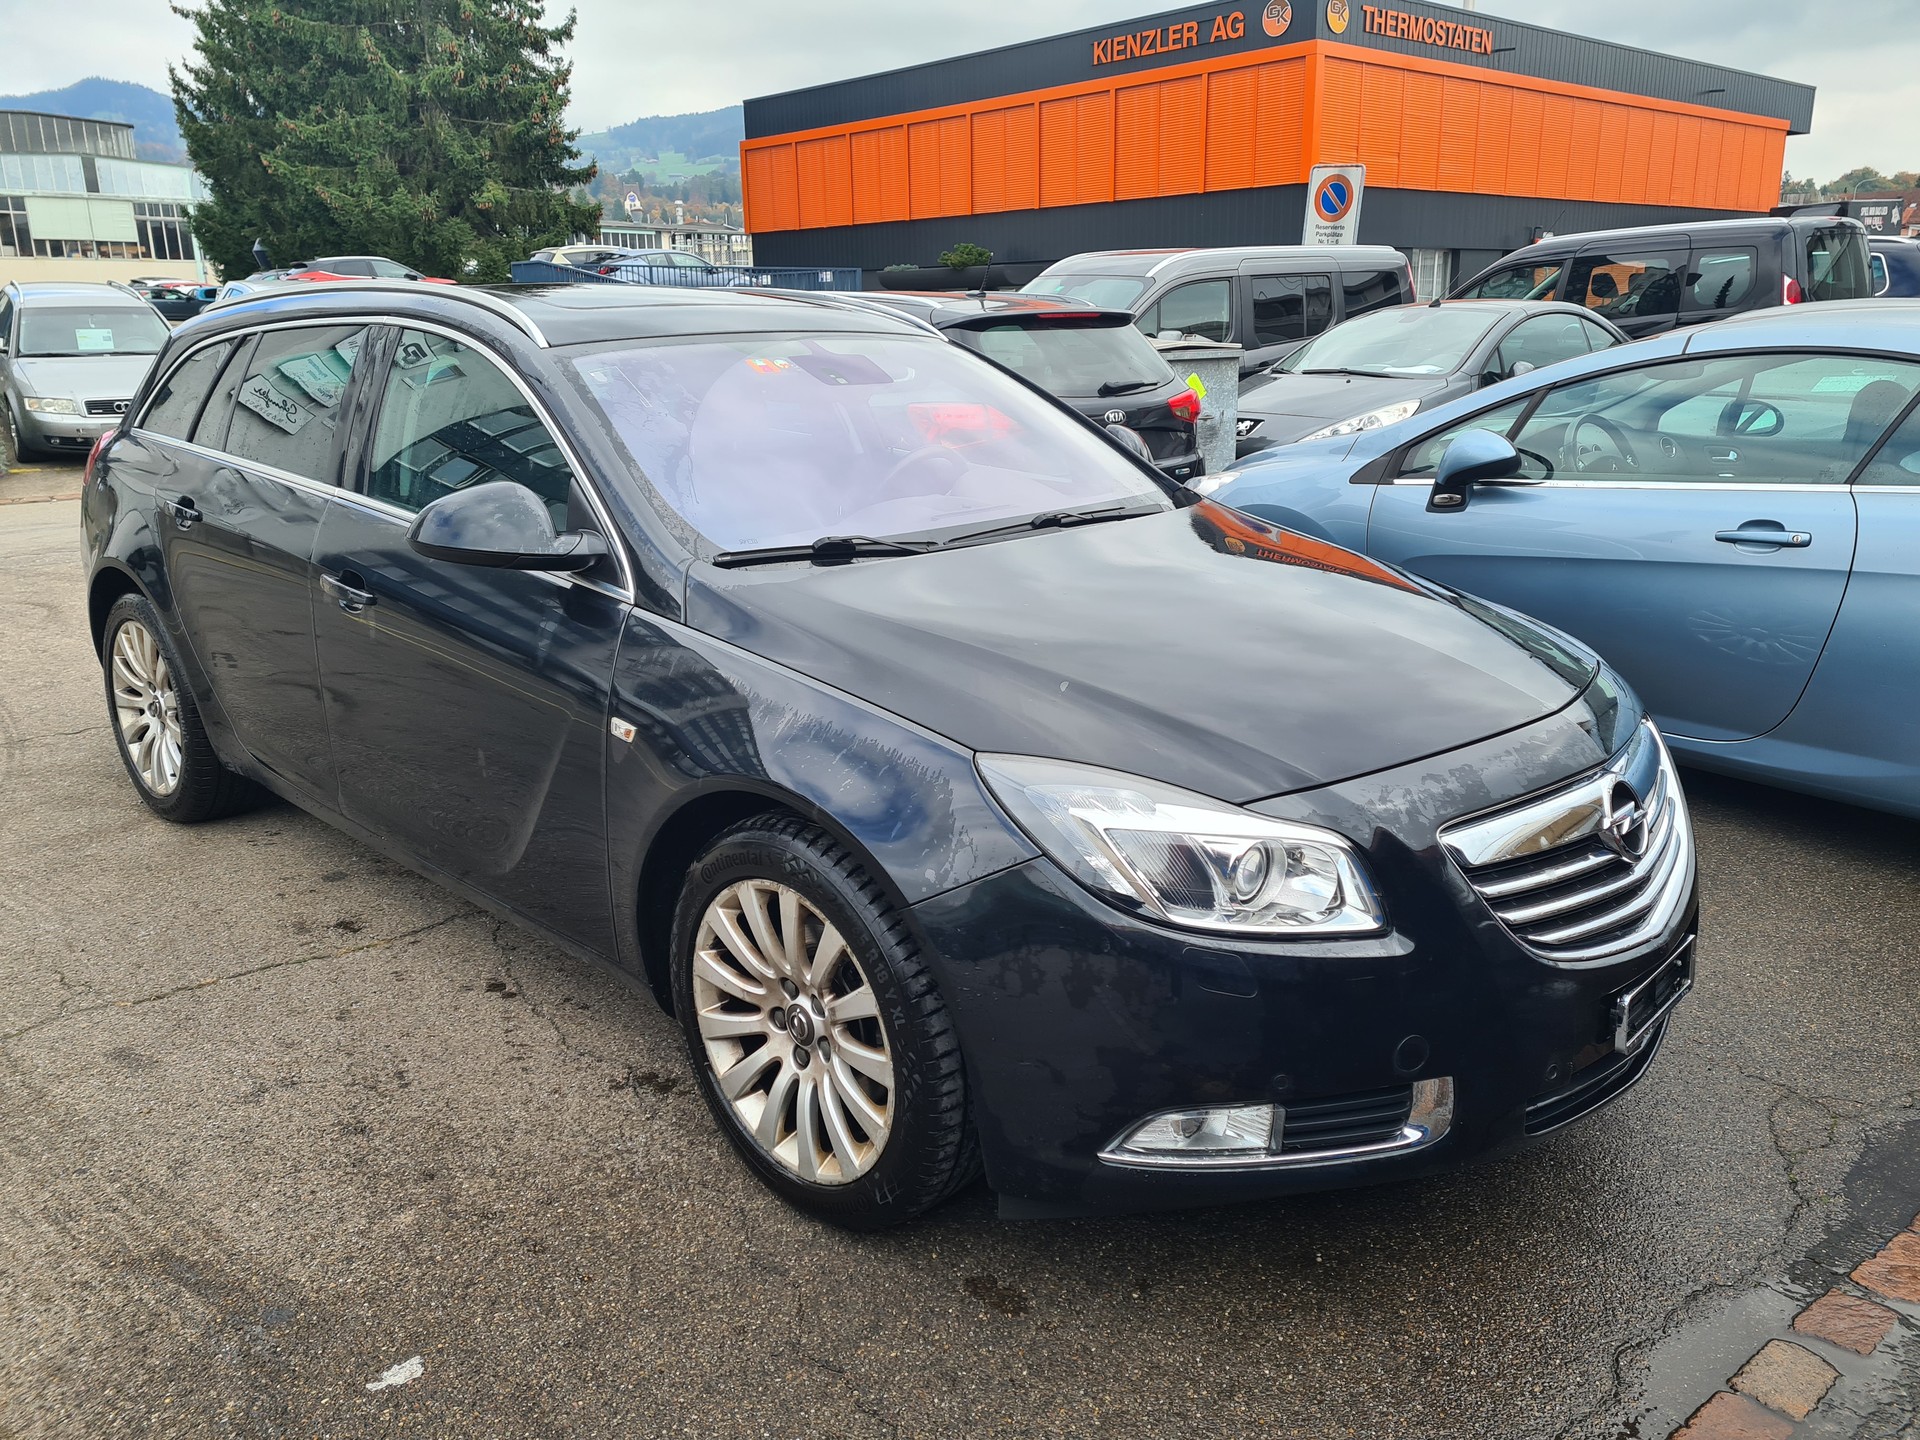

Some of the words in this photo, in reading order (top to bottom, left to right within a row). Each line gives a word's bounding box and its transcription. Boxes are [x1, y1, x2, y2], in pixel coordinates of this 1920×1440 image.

[1266, 4, 1289, 25] GK
[1329, 0, 1347, 23] GK
[1092, 21, 1198, 65] KIENZLER
[1209, 11, 1245, 43] AG
[1362, 5, 1494, 55] THERMOSTATEN
[1108, 412, 1124, 422] KIA
[700, 849, 763, 885] Continental
[865, 948, 879, 965] R
[873, 963, 890, 984] 18
[890, 1006, 906, 1031] XL
